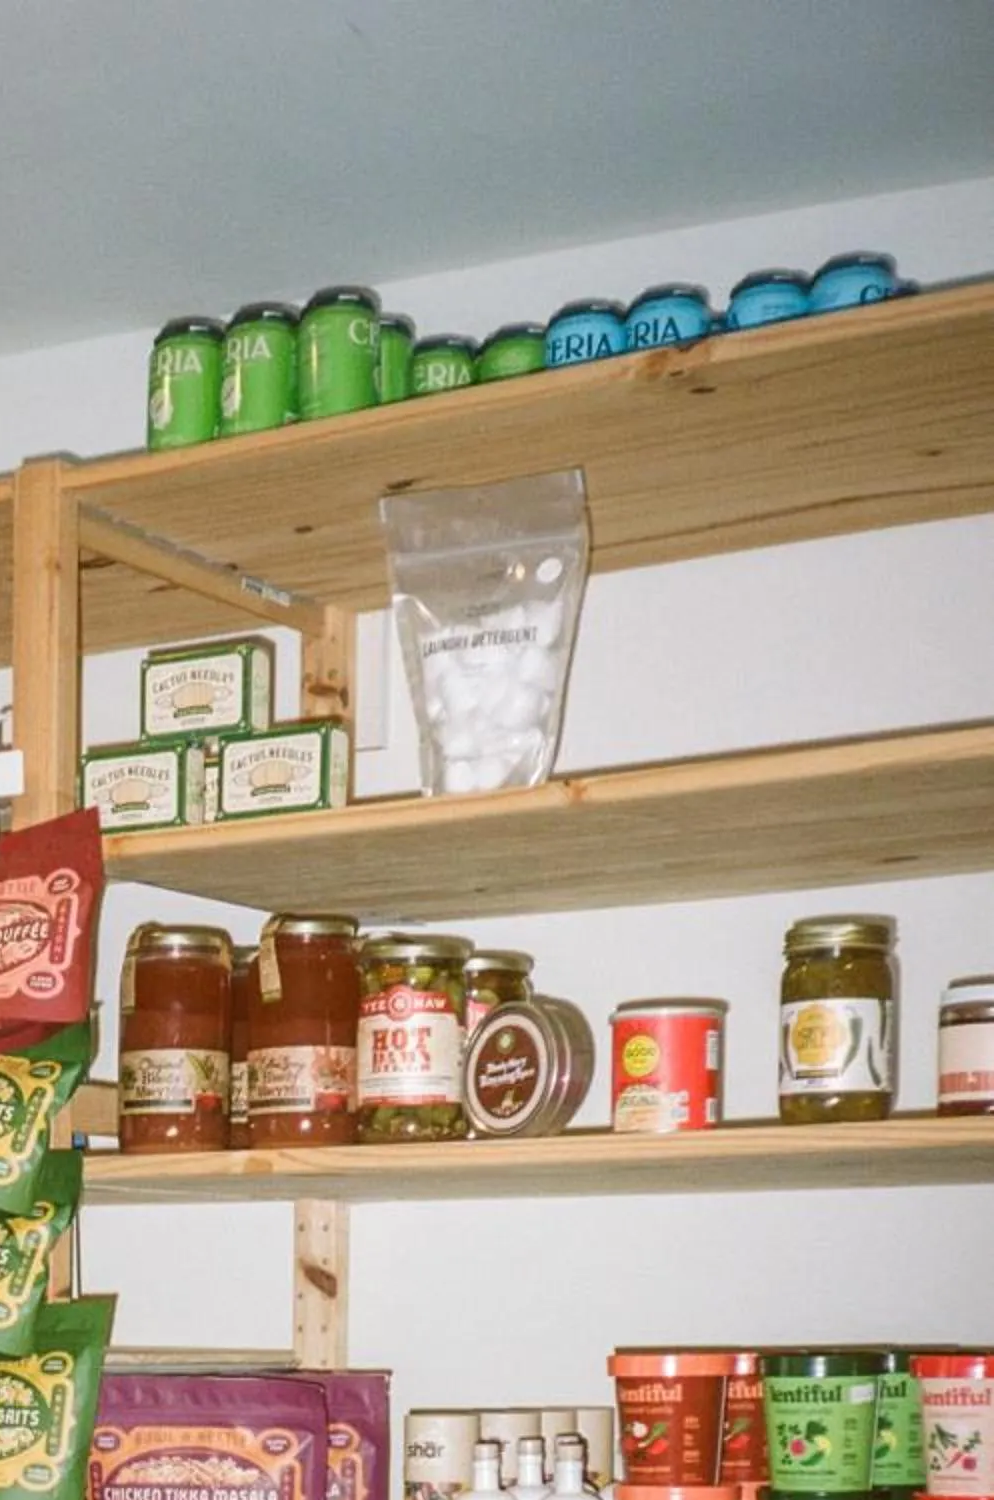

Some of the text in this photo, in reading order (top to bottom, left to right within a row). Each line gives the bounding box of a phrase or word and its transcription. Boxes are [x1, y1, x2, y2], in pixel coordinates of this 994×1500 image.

[152, 668, 235, 694] CACTUS NEEDLES
[230, 748, 314, 770] CACTUS NEEDLES
[91, 766, 170, 788] CACTUS NEEDLES
[372, 1027, 432, 1050] HOT
